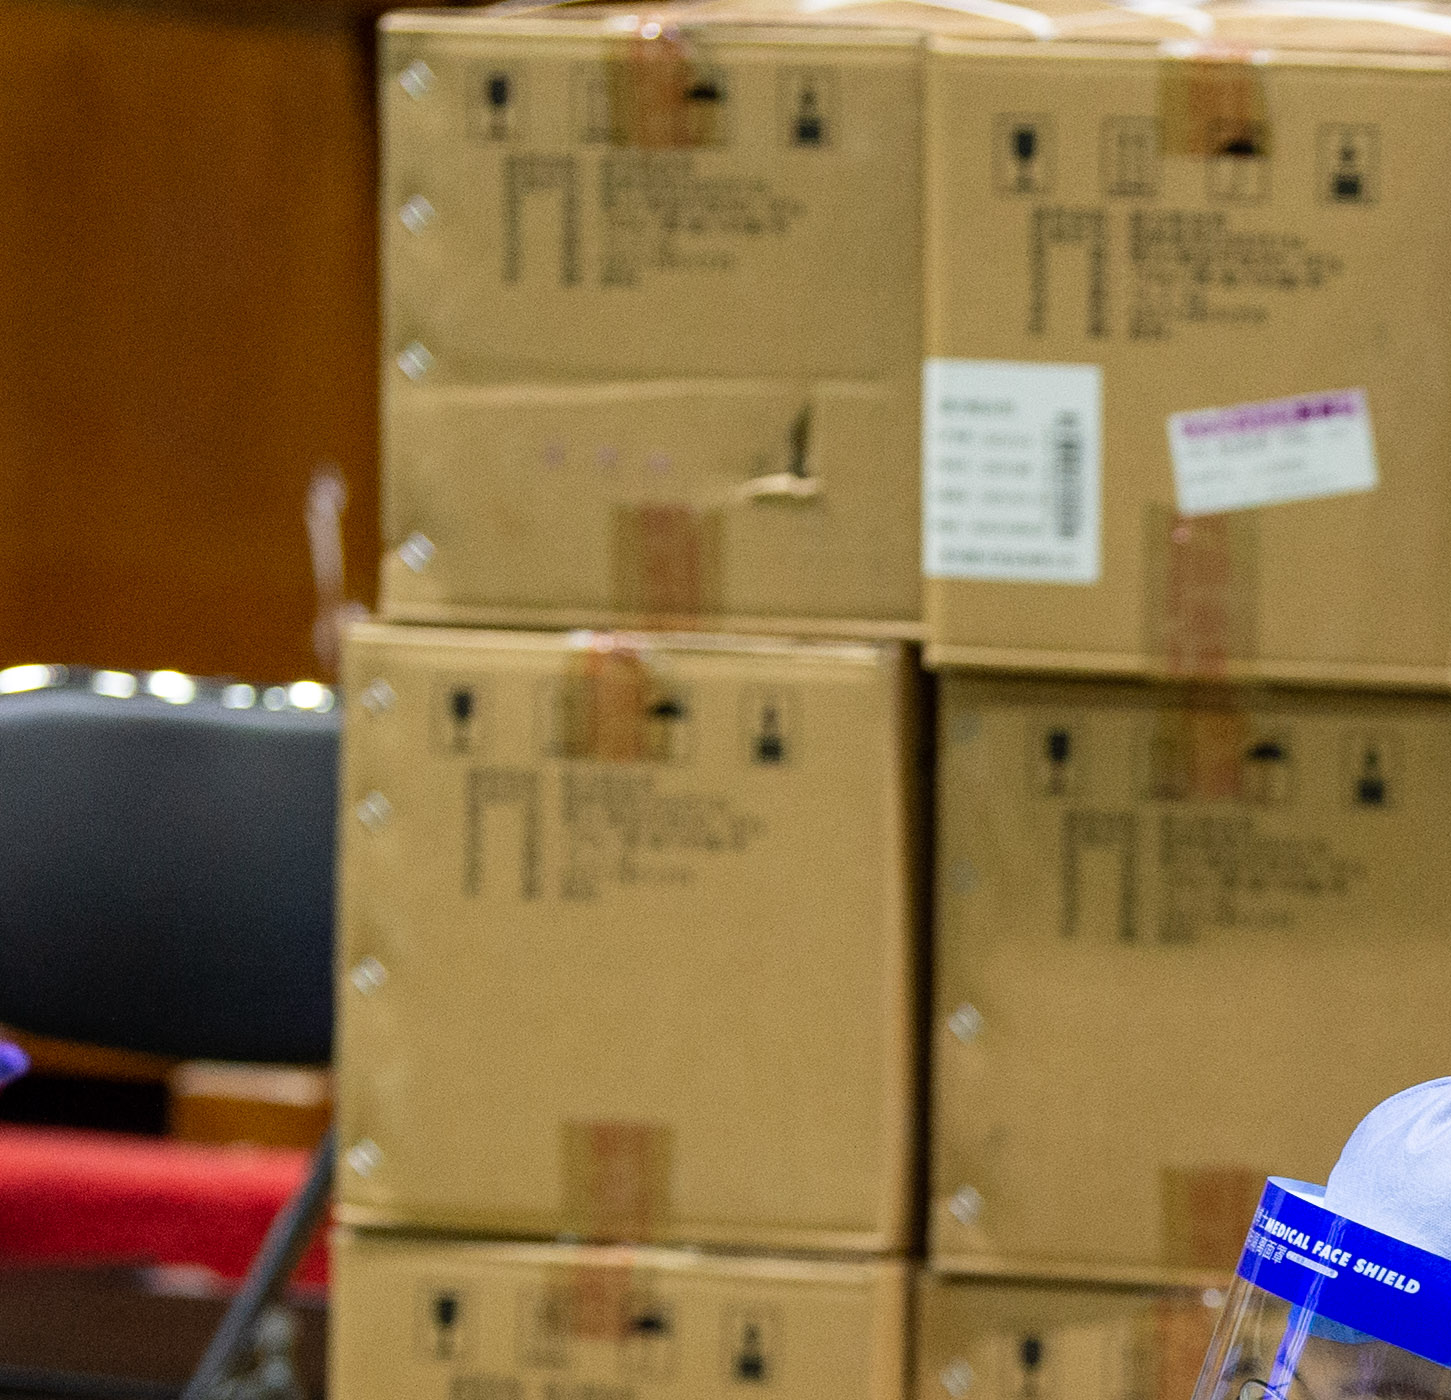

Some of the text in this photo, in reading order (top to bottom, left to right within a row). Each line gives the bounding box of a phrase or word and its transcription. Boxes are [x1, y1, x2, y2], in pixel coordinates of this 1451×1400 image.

[1264, 1217, 1421, 1295] MEDICAL FACE SHIELD
